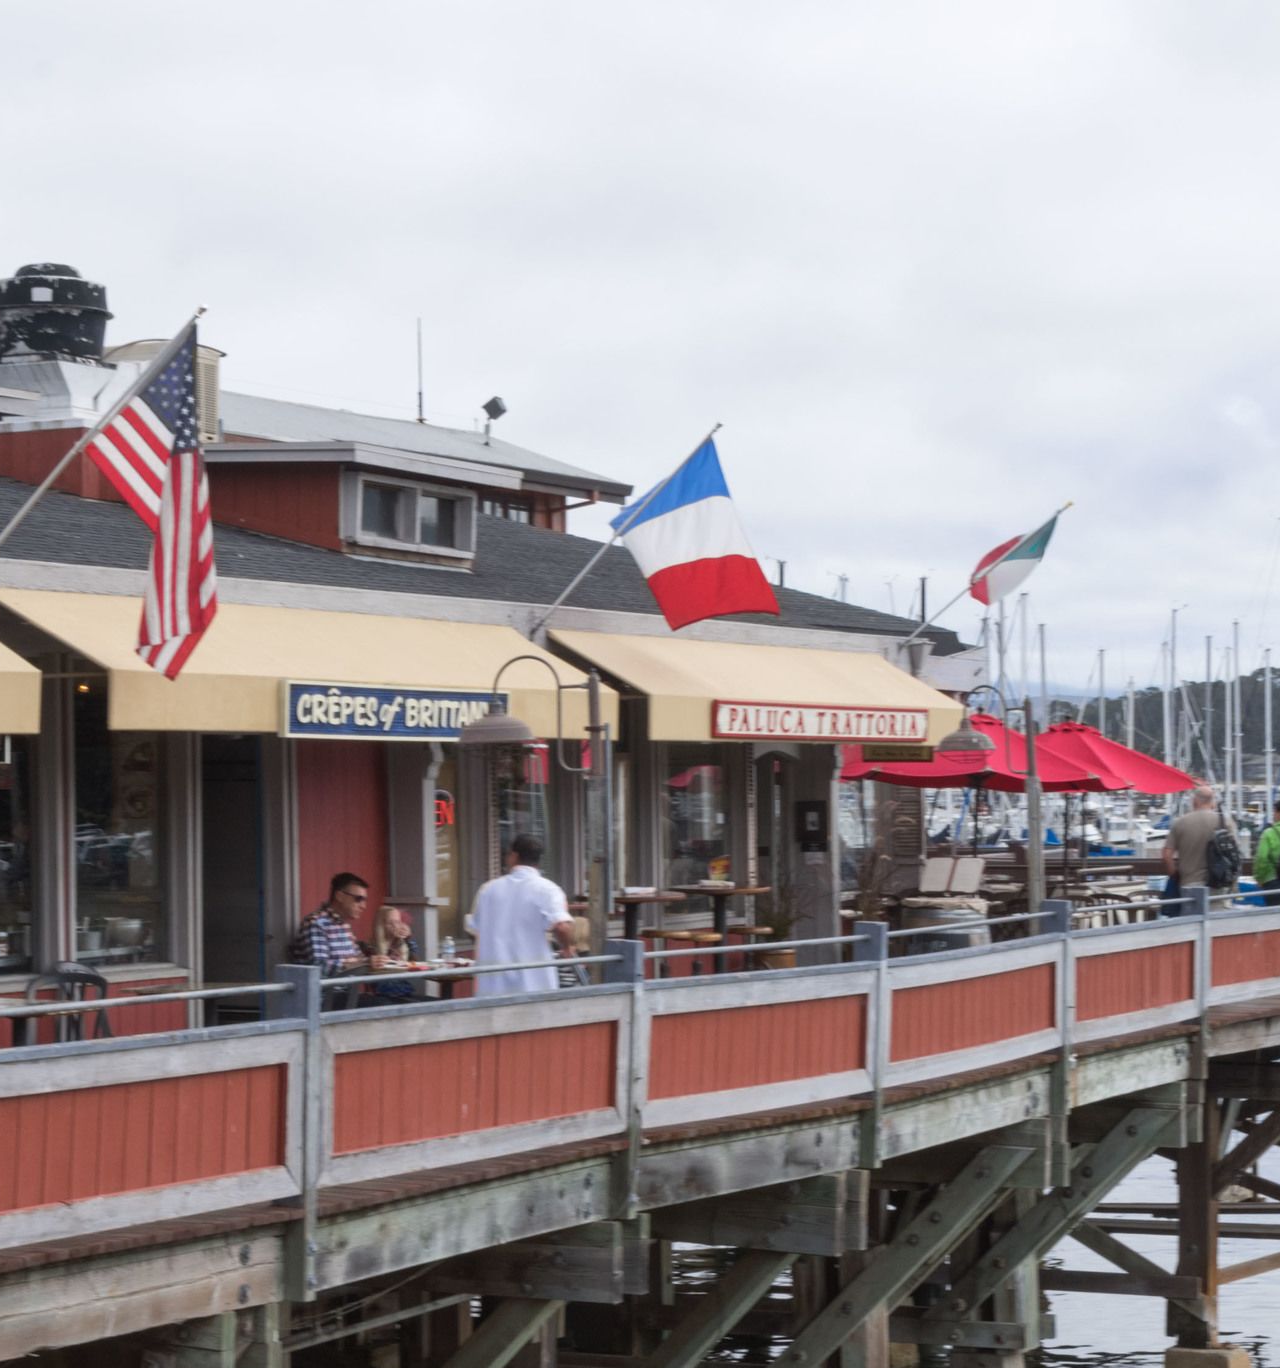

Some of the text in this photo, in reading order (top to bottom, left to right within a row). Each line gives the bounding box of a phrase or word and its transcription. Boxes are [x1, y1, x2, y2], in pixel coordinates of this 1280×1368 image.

[296, 687, 489, 731] CRÊPES of BRITTAN
[727, 707, 921, 737] PALUCA TRATTORIA
